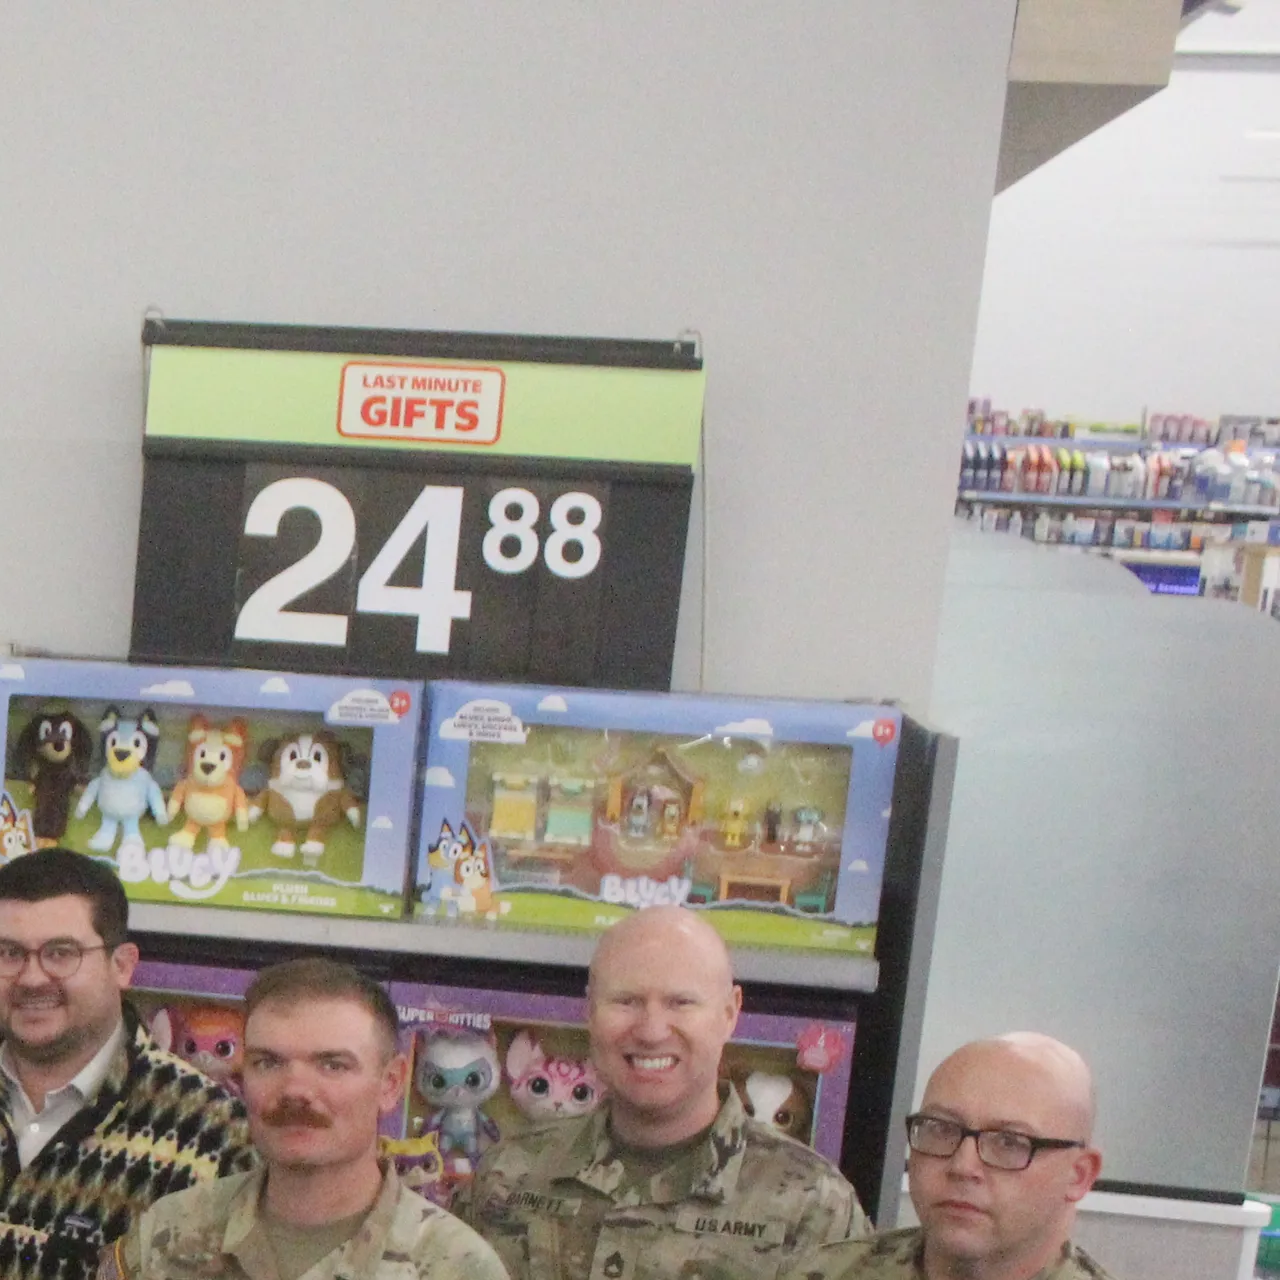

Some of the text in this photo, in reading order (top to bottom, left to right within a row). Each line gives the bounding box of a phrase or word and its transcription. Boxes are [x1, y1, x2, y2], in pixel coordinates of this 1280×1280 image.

[361, 374, 482, 395] LAST MINUTE
[359, 394, 480, 432] GIFTS
[717, 1220, 768, 1239] ARMY
